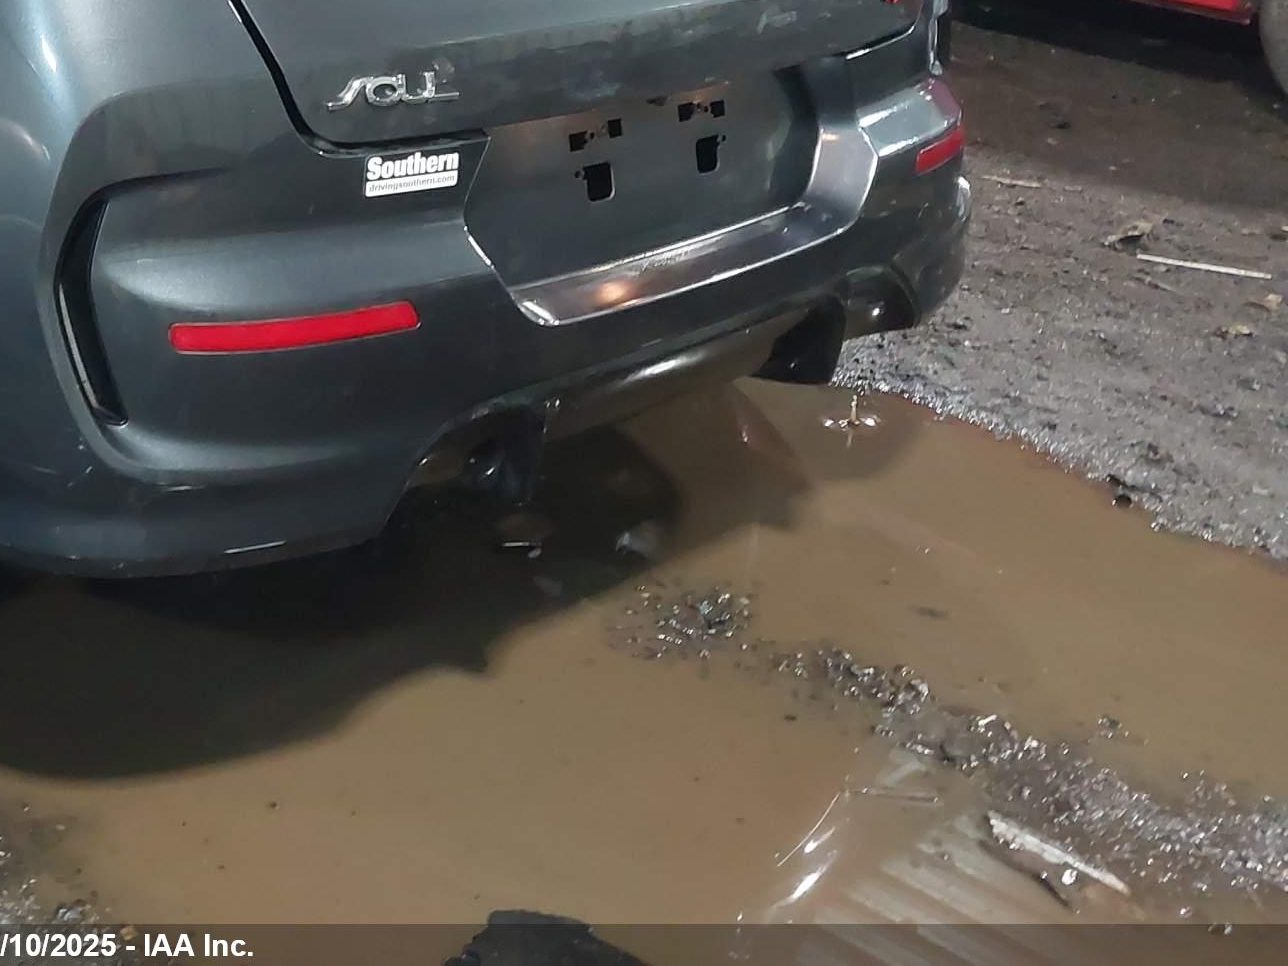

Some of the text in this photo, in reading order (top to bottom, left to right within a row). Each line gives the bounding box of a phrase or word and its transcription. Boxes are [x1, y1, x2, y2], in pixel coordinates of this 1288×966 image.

[325, 71, 460, 112] SOUL
[366, 151, 460, 181] Southern
[368, 175, 455, 193] drivingsouthern.com
